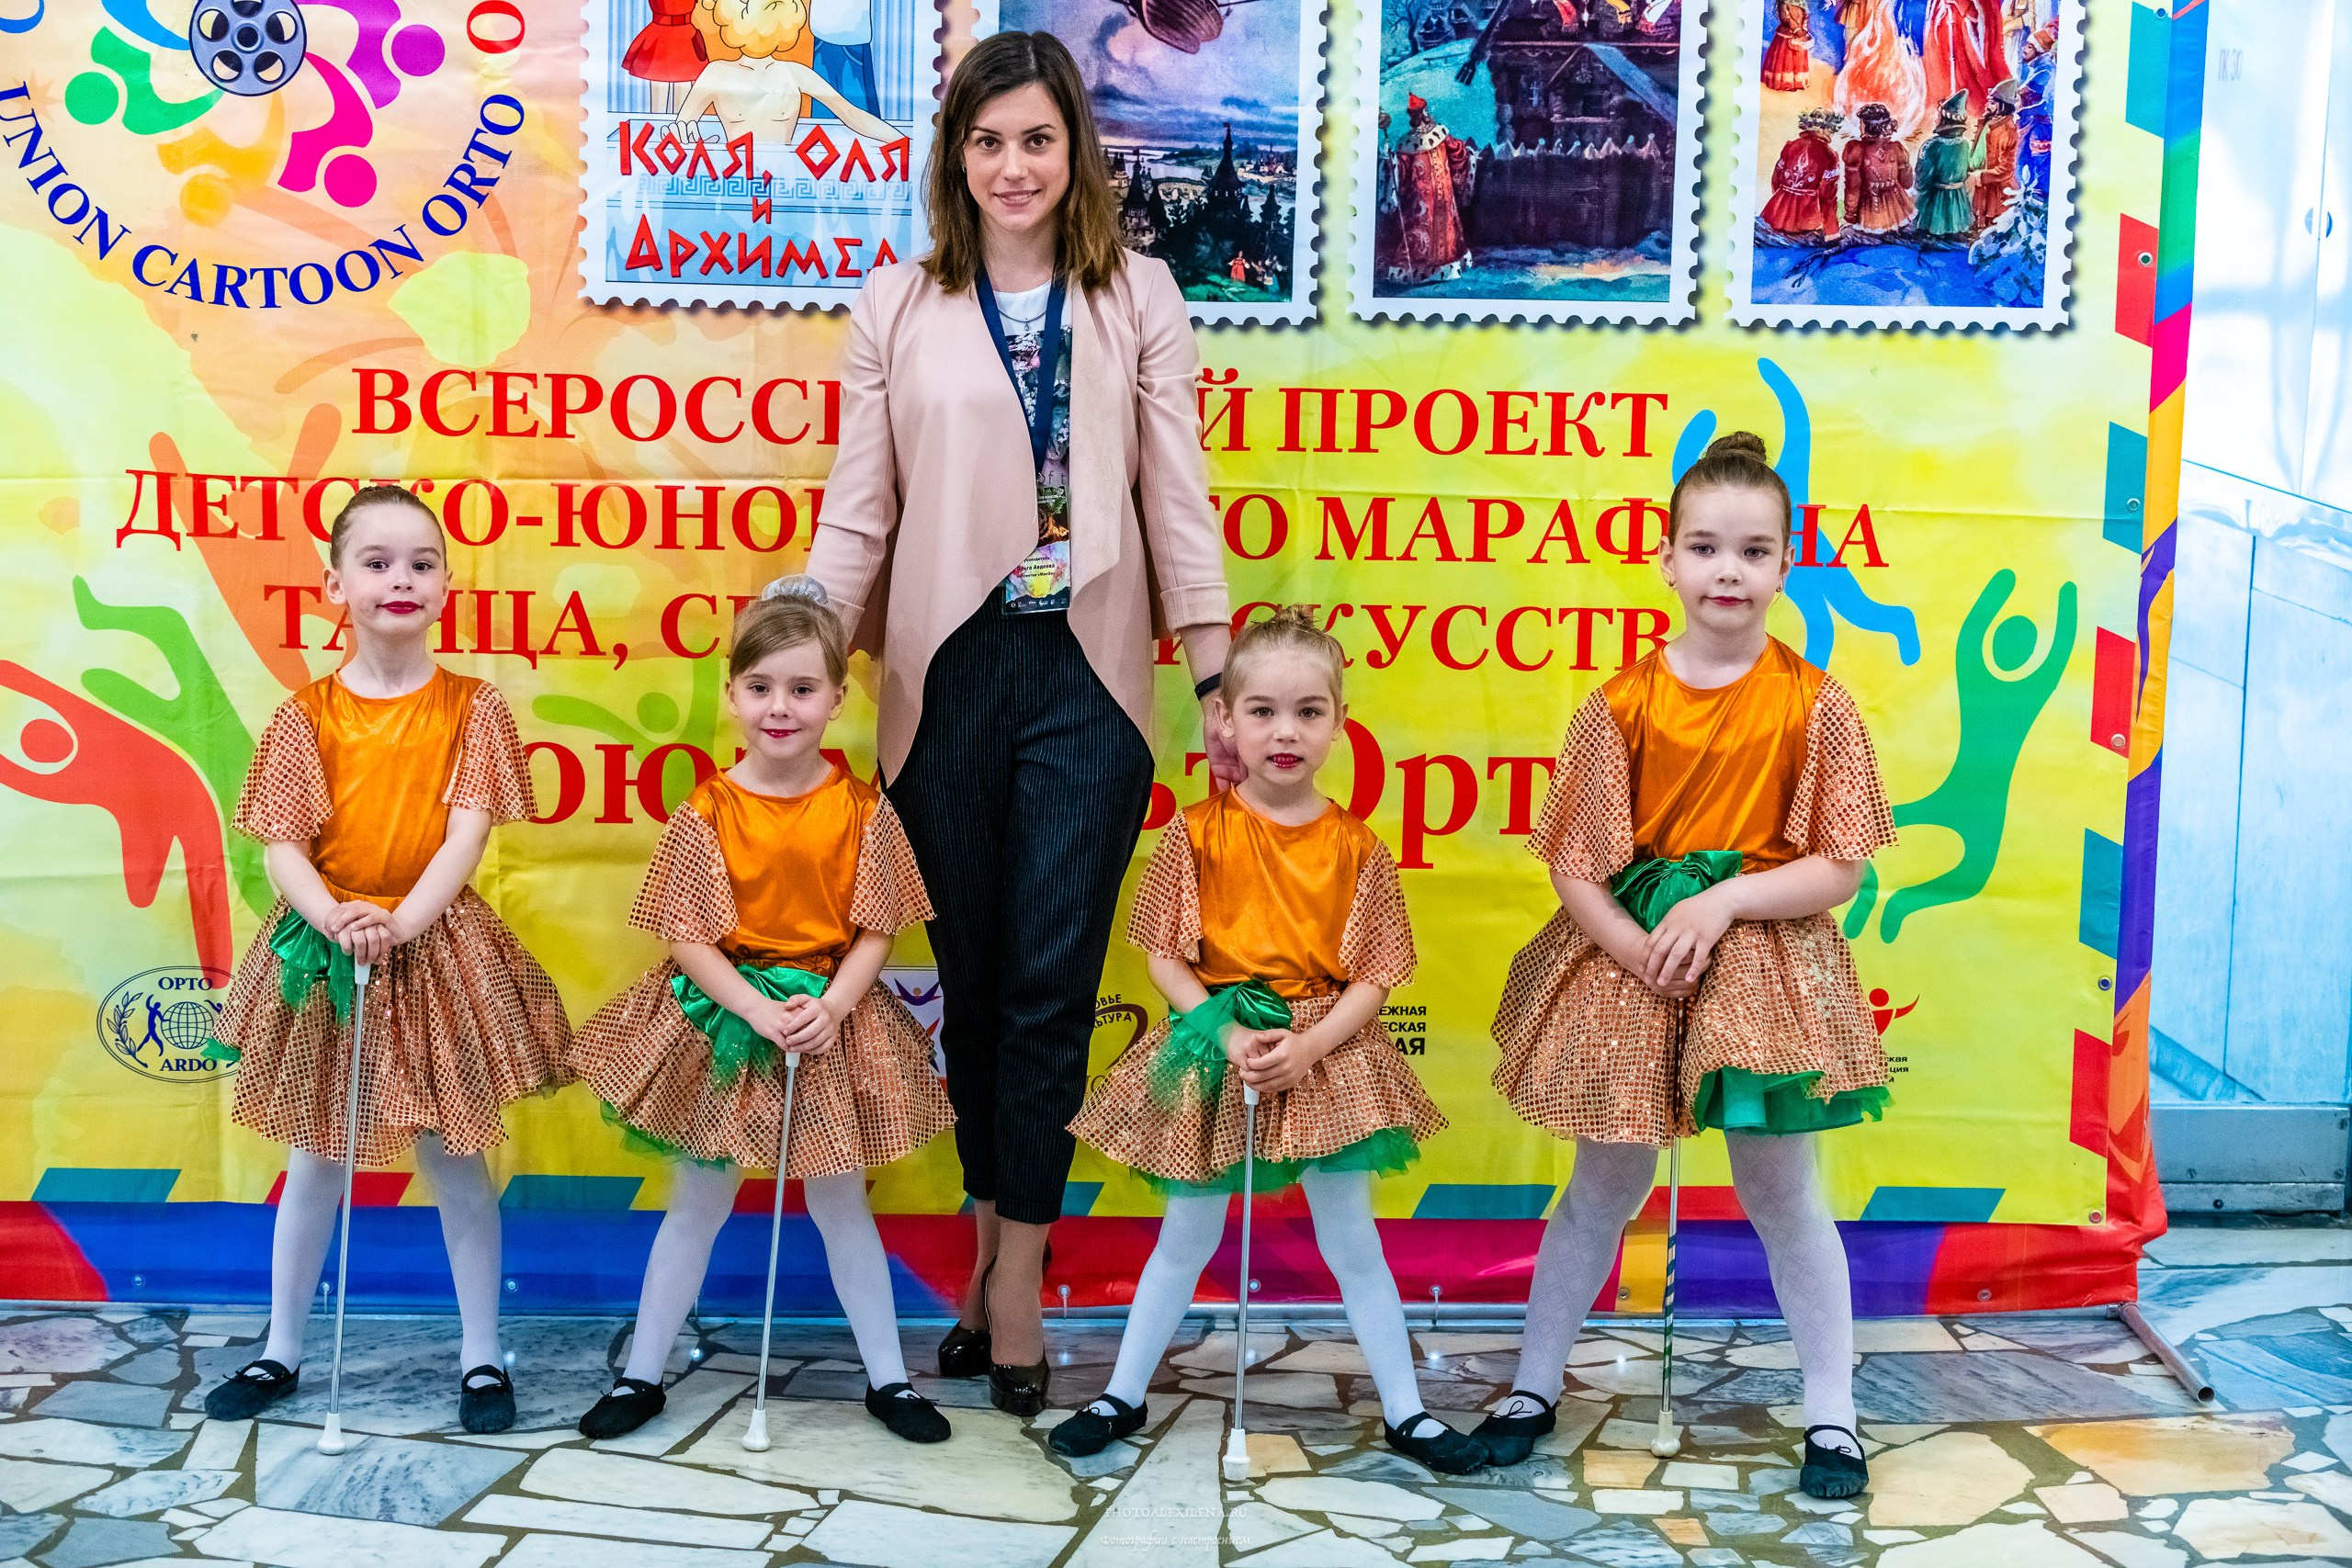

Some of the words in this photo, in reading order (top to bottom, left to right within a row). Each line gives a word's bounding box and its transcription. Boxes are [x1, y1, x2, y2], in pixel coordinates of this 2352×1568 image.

[0, 81, 131, 261] UNION
[132, 225, 425, 310] CARTOON
[421, 93, 525, 236] ORTO
[1277, 388, 1668, 458] ПРОЕКТ
[159, 1058, 218, 1072] ARDO
